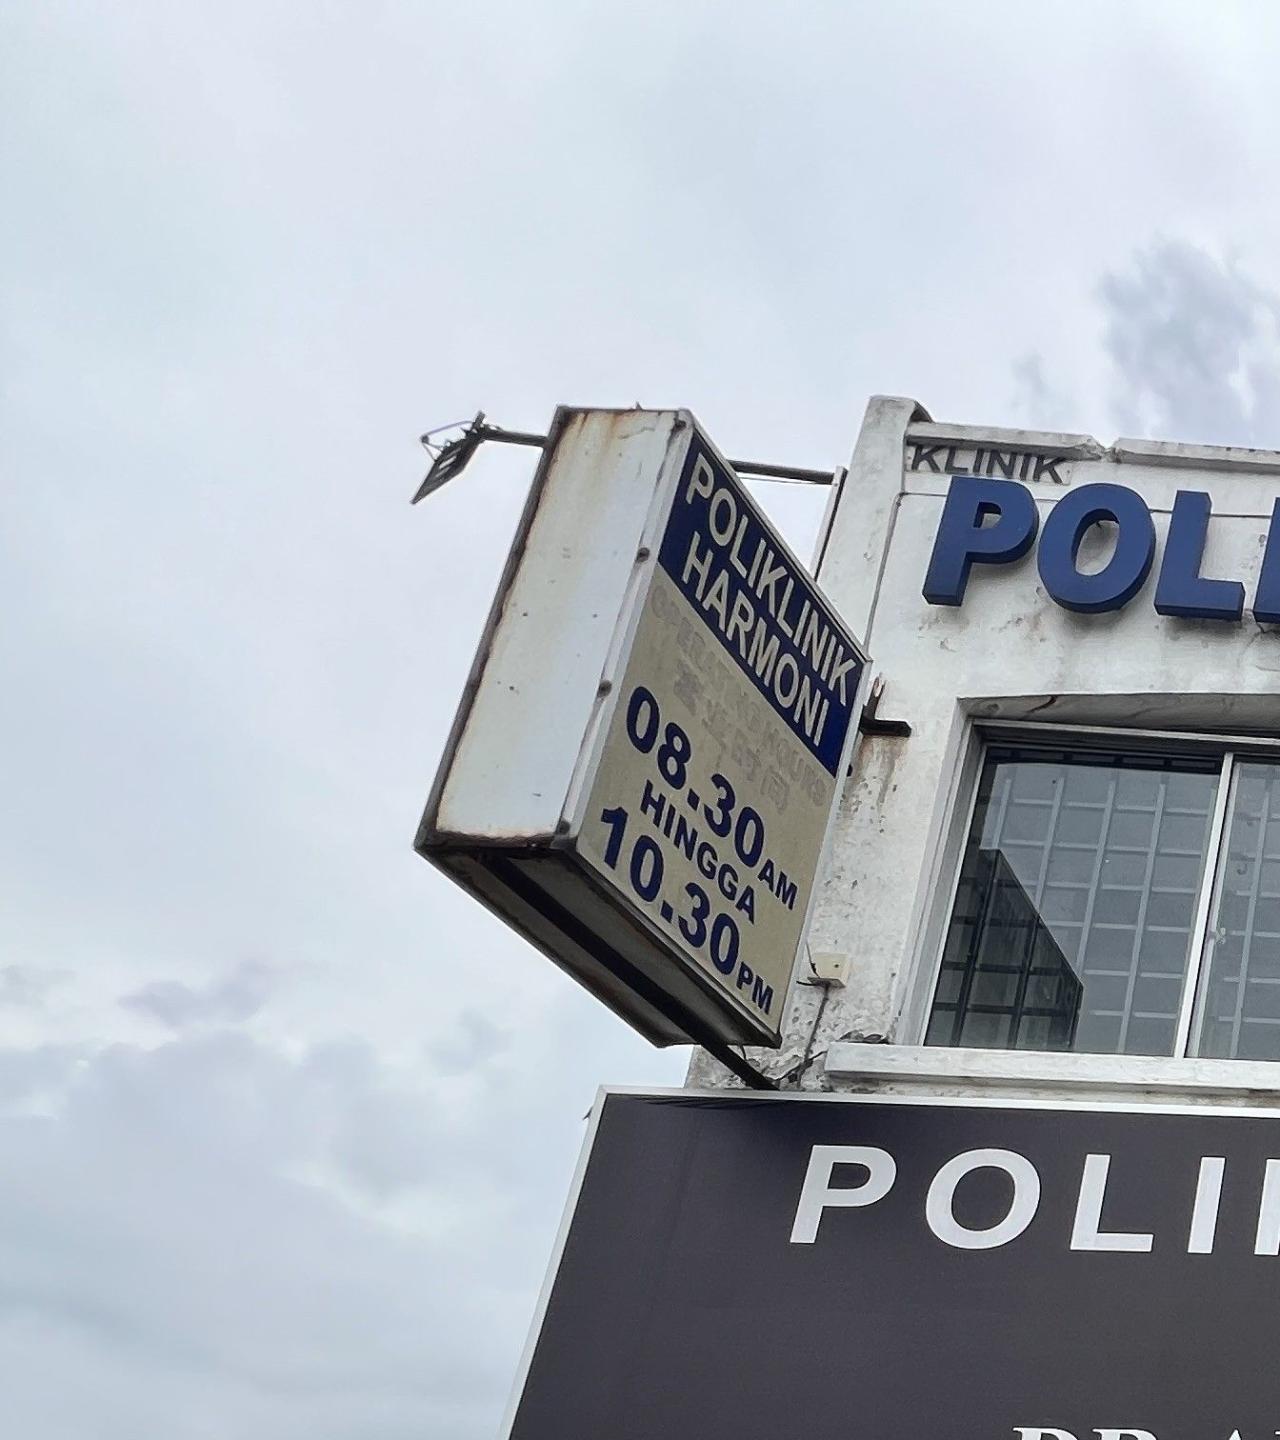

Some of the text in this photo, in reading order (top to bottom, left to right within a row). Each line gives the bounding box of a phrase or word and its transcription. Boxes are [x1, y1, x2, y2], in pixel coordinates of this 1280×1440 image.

[911, 443, 1067, 485] KLINIK
[682, 531, 831, 747] HARMONI
[686, 452, 858, 707] POLIKLINIK
[640, 782, 757, 924] HINGGA
